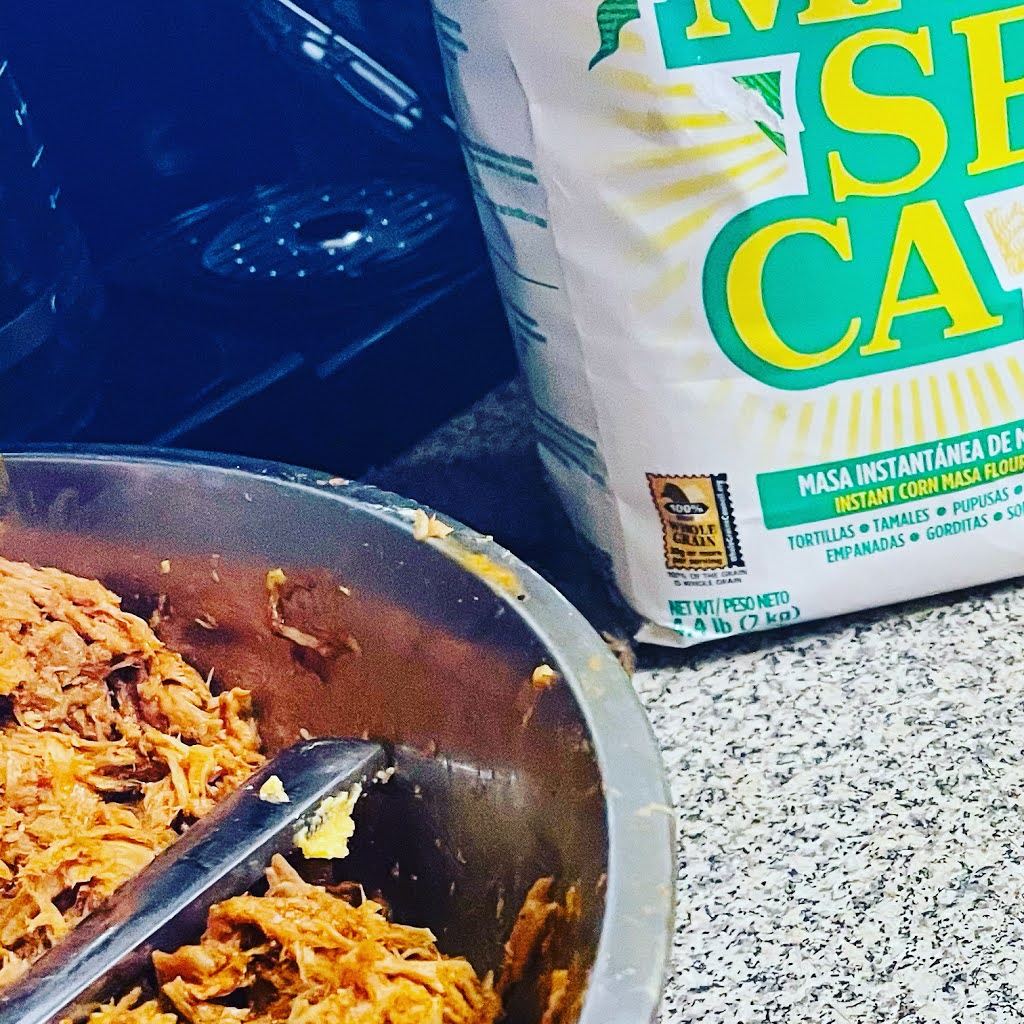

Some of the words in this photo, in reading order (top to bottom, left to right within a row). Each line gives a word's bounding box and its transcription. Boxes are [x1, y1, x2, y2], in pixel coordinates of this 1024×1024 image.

[726, 199, 1003, 371] CA
[798, 467, 854, 497] MASA
[856, 438, 985, 486] INSTANTÁNEA
[987, 430, 1013, 457] DE
[669, 504, 704, 513] 100%
[834, 486, 895, 513] INSTANT
[898, 476, 939, 500] CORN
[941, 467, 983, 491] MASA
[787, 524, 855, 550] TORTILLAS
[873, 508, 930, 533] TAMALES
[952, 487, 1009, 515] PUPUSAS
[826, 533, 906, 563] EMPANADAS
[926, 513, 988, 540] GORDITAS
[668, 600, 692, 616] NET
[757, 590, 790, 609] NETO
[711, 618, 733, 634] lb
